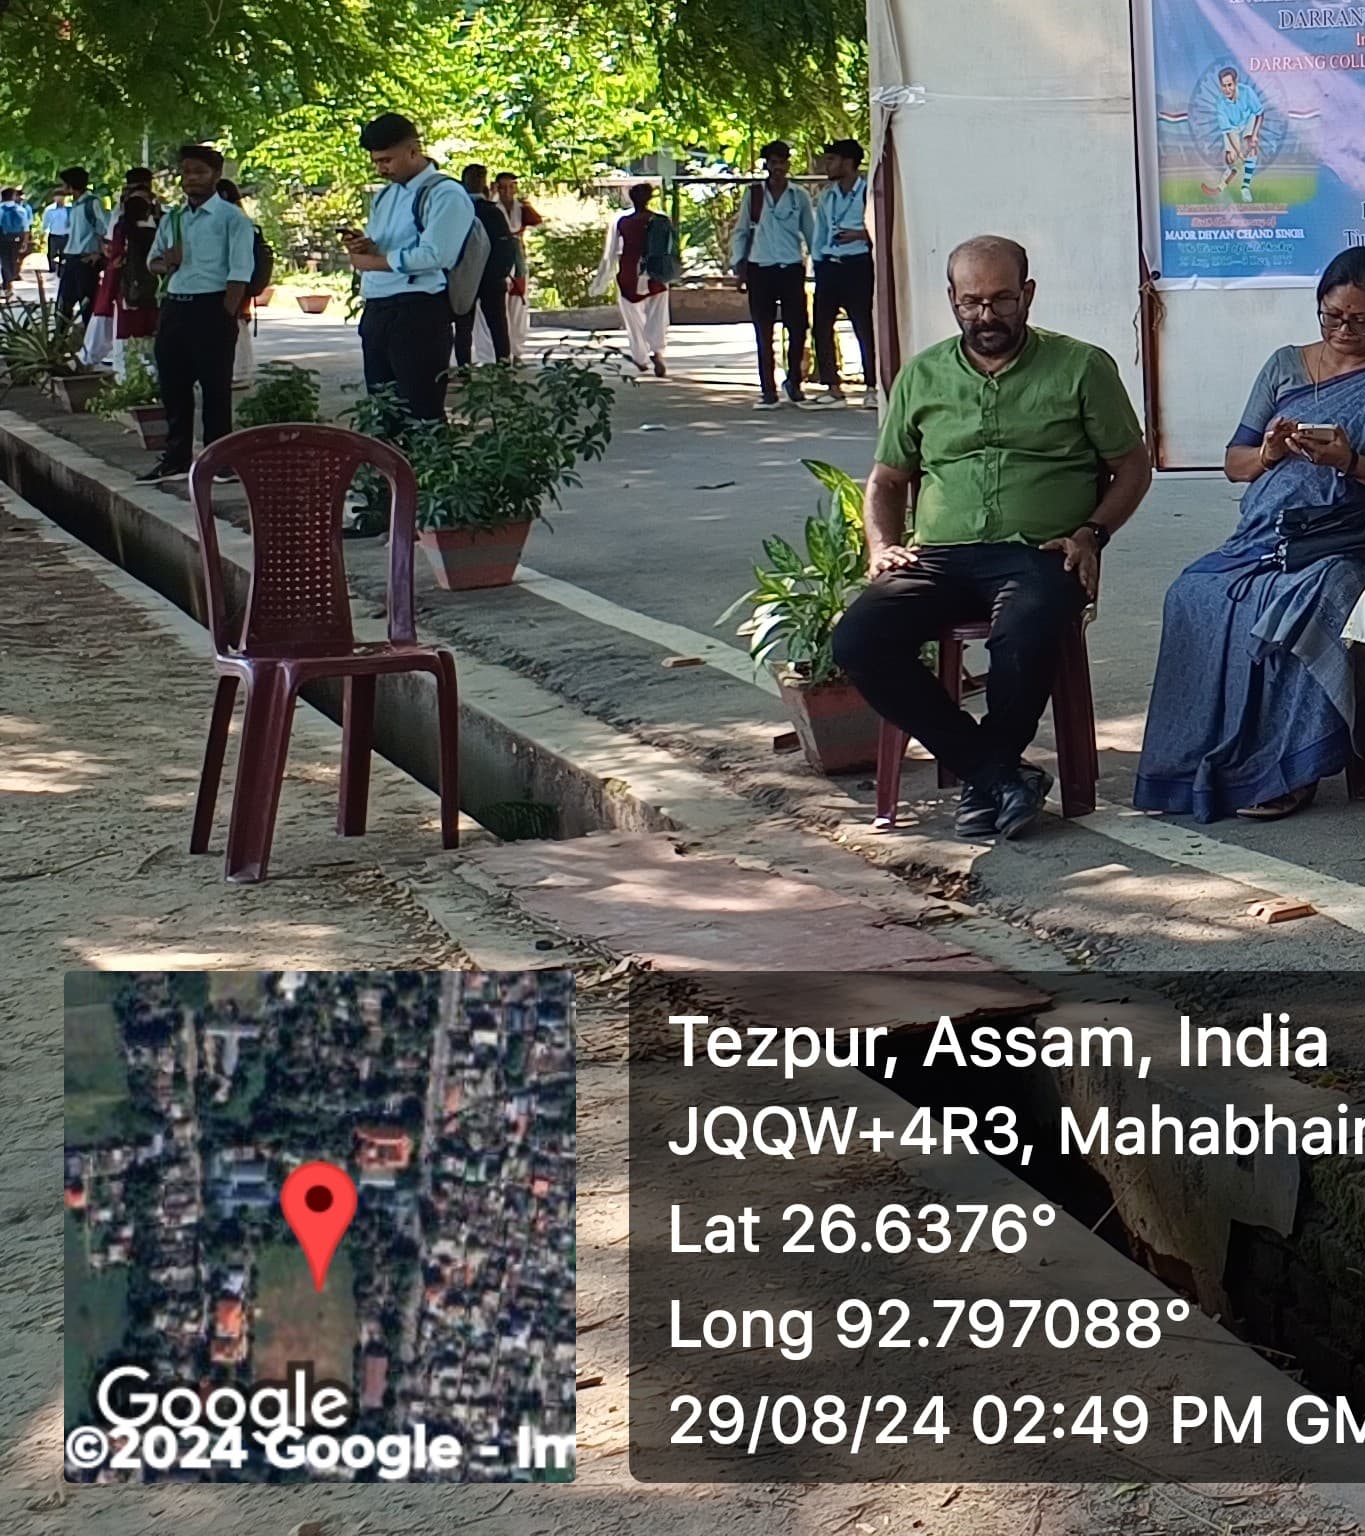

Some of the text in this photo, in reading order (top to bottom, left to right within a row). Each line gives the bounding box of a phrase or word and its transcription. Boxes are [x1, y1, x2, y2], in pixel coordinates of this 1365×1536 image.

[1250, 55, 1326, 72] DARRANG
[1165, 228, 1305, 240] MAJOR DHYAN CHAND SINGH
